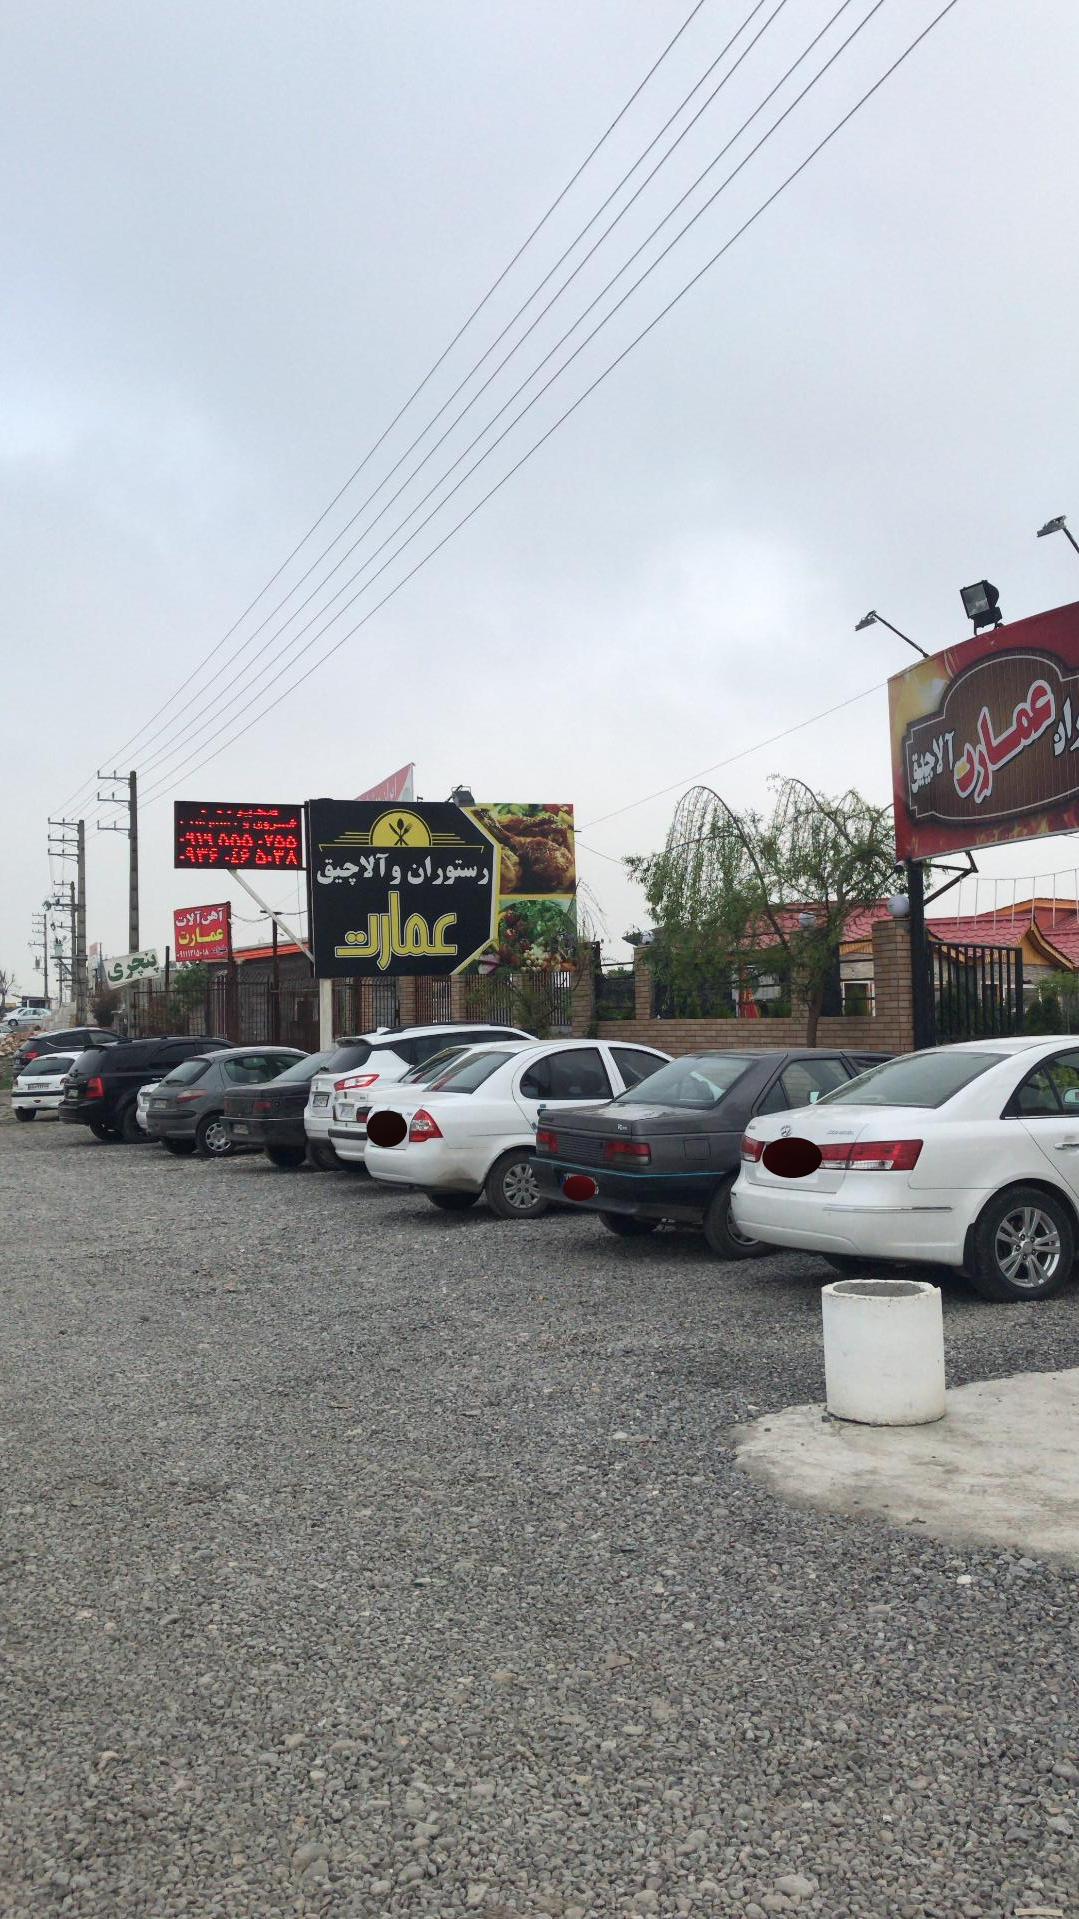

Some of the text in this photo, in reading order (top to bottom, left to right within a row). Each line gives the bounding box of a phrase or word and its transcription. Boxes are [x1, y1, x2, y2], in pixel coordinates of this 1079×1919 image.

[954, 680, 1055, 804] عمارت
[316, 852, 490, 886] رستوران و آلاچیق
[175, 907, 224, 927] آهن آلات
[334, 890, 458, 972] عمارت
[178, 926, 224, 947] عمارت
[107, 951, 160, 983] پنچری
